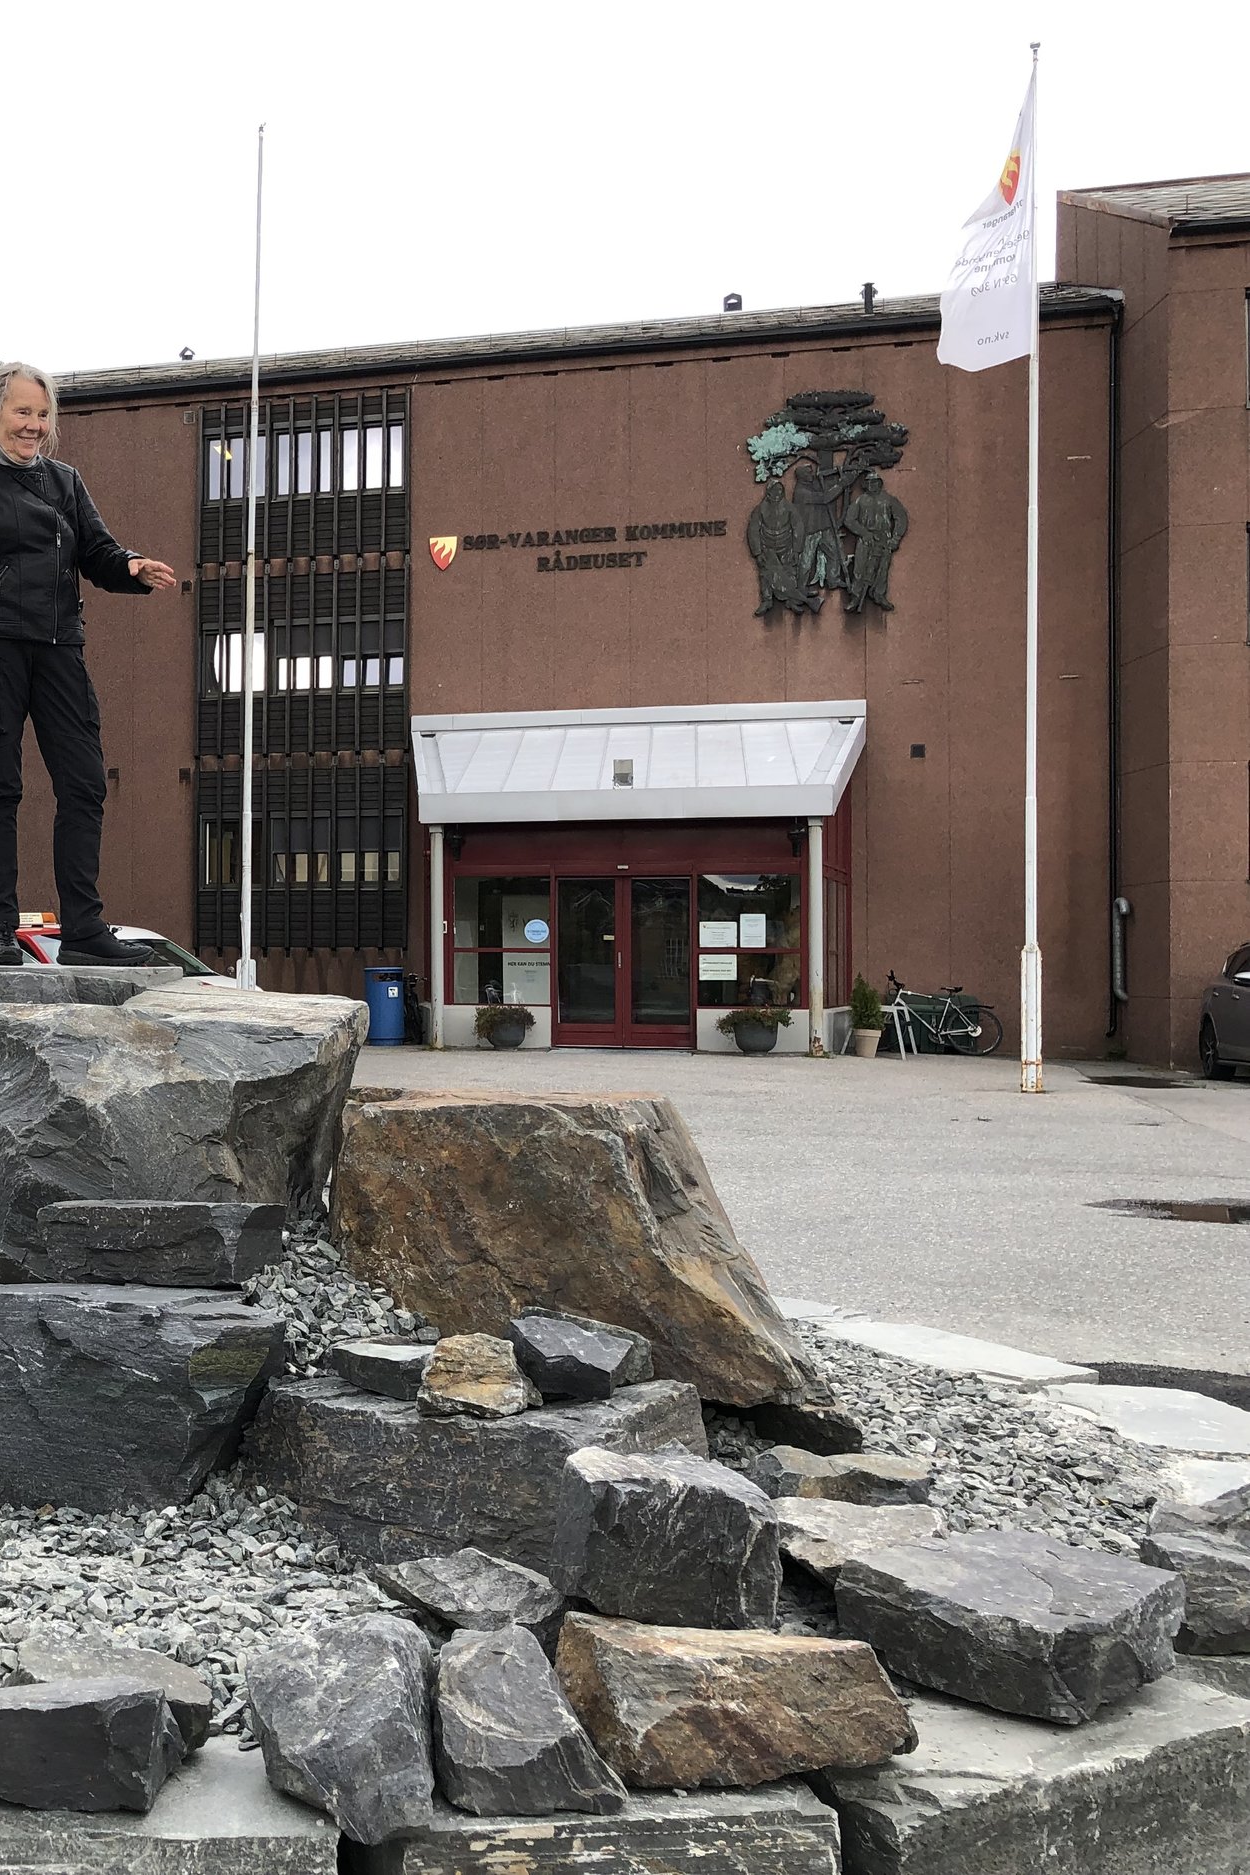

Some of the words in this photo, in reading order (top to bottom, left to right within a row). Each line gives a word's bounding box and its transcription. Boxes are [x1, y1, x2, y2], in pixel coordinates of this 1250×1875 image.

[462, 526, 617, 551] SØR-VARANGER
[625, 520, 728, 542] KOMMUNE
[536, 550, 648, 572] RÅDHUSET
